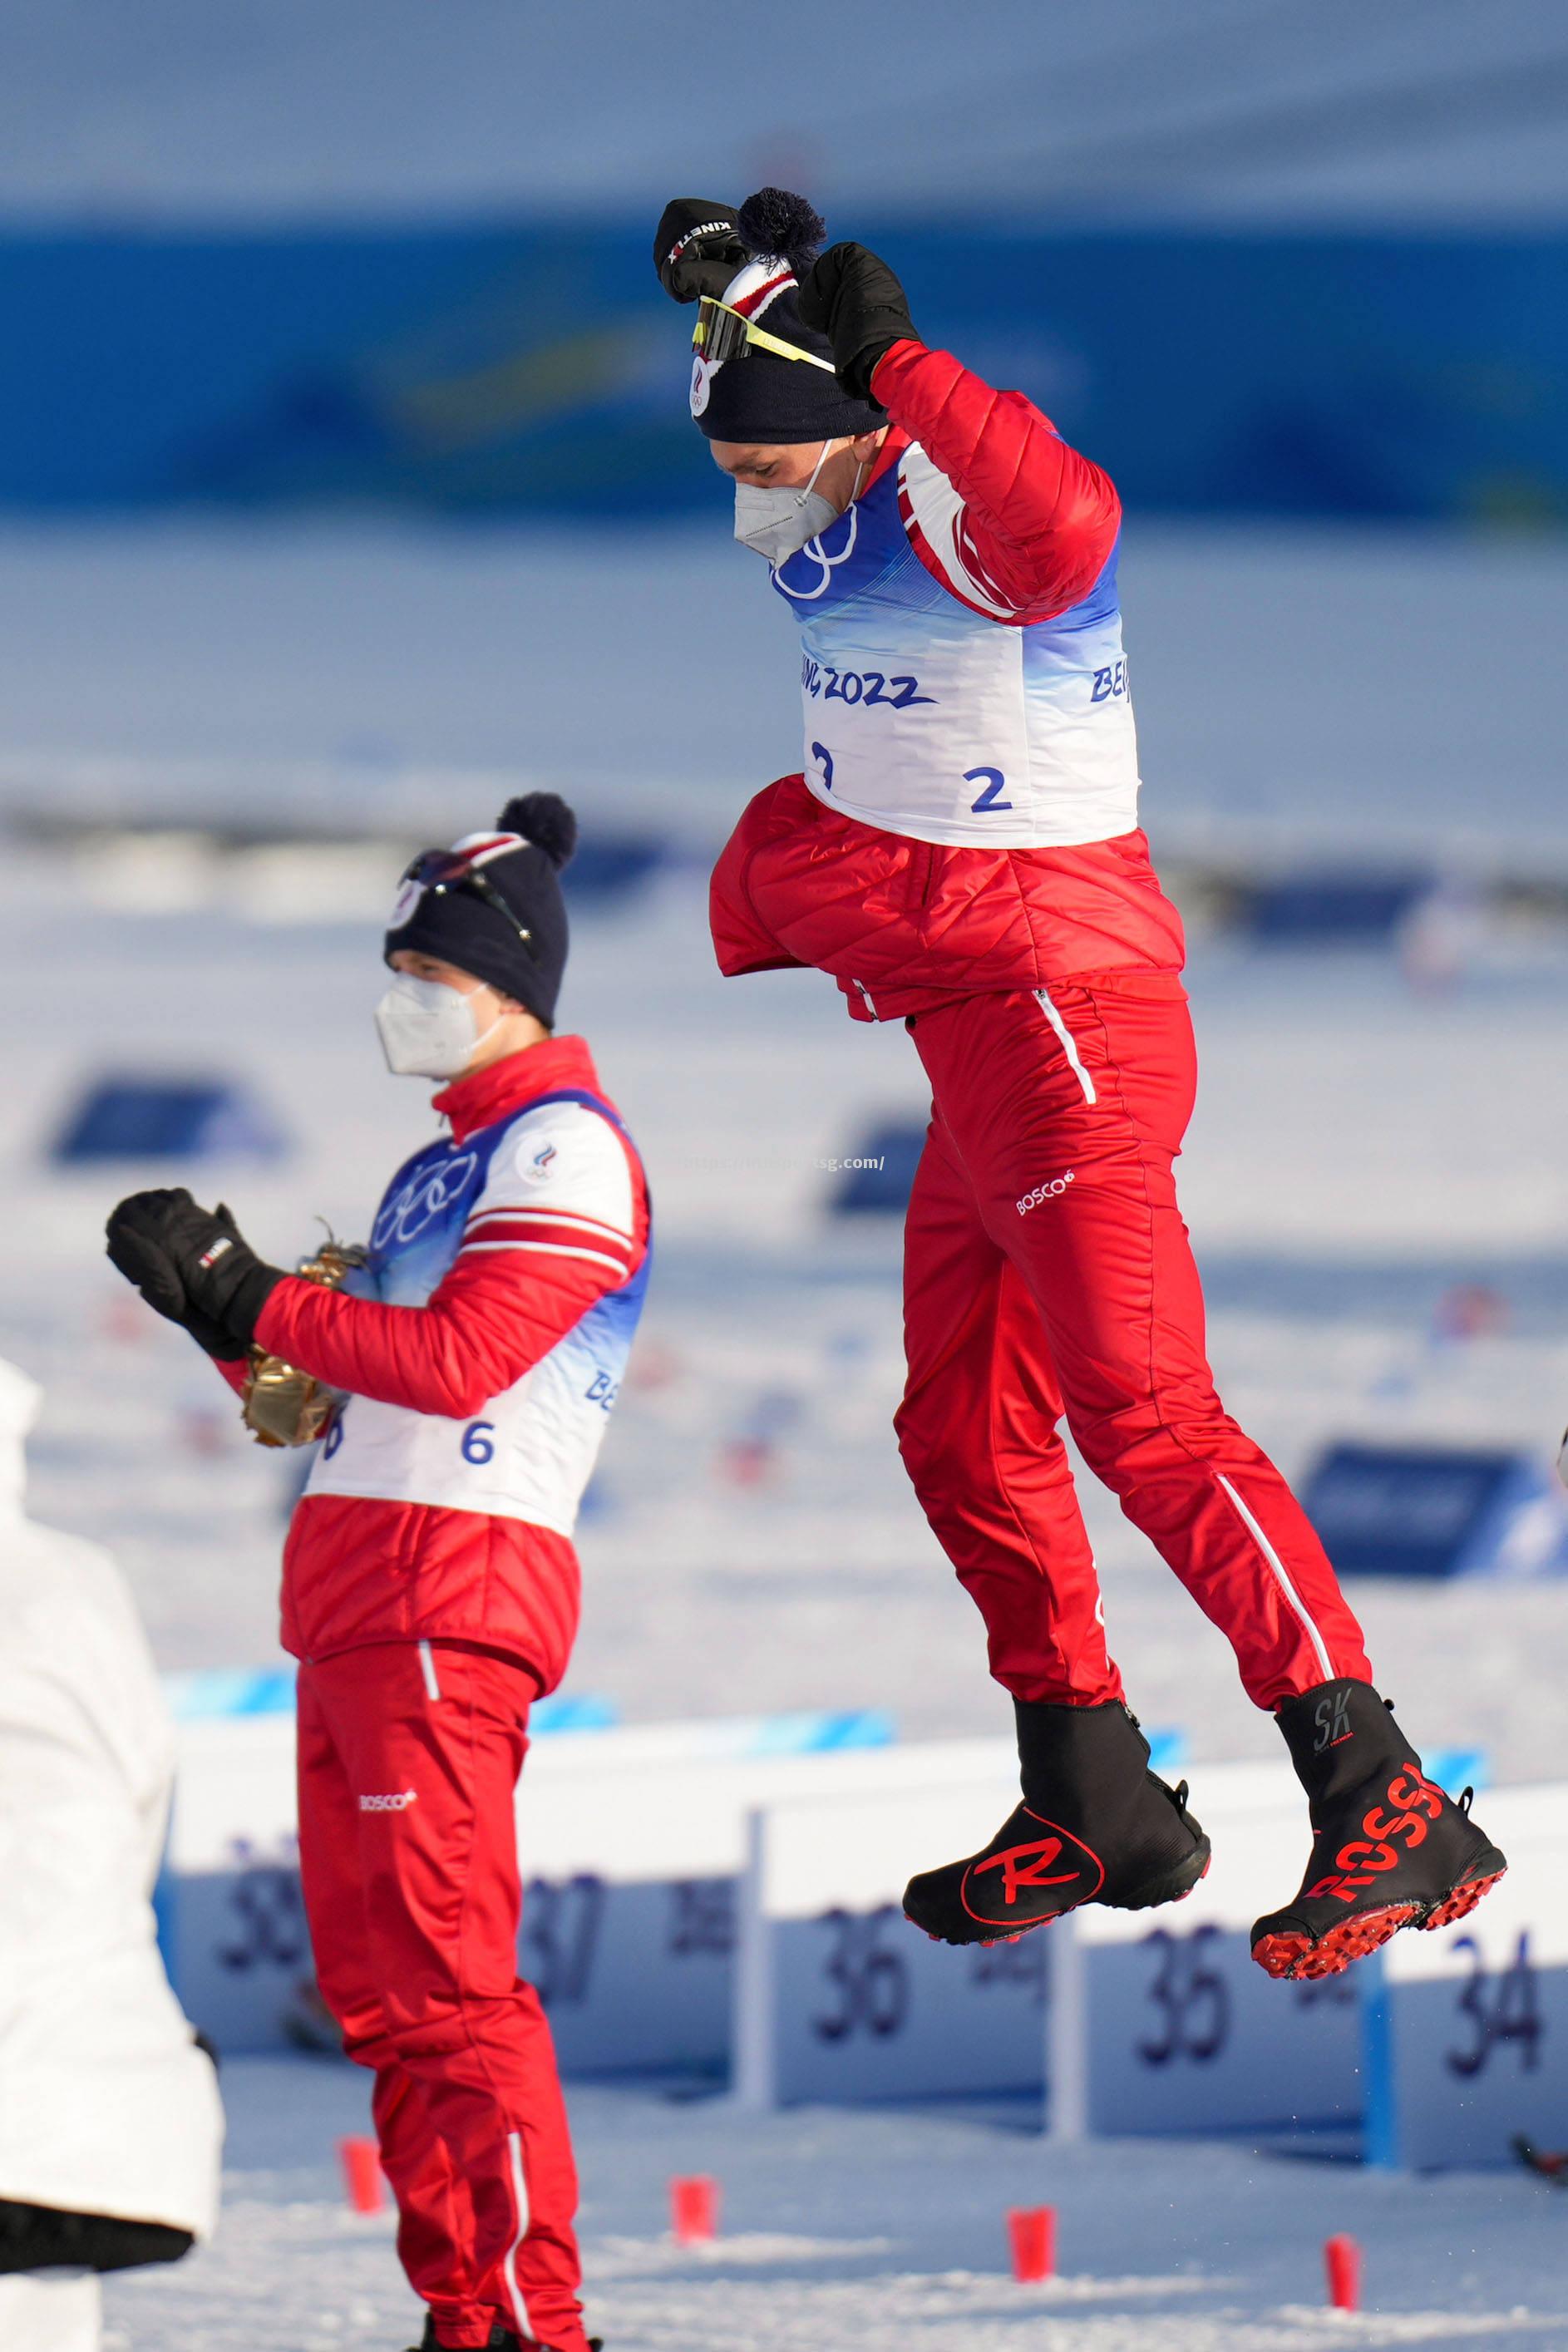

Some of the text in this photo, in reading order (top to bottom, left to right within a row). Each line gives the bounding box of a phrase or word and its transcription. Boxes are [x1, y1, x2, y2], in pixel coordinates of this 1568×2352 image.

[824, 668, 940, 709] 2022
[963, 767, 1013, 813] 2
[461, 1421, 495, 1464] 6
[974, 1837, 1080, 1904] R
